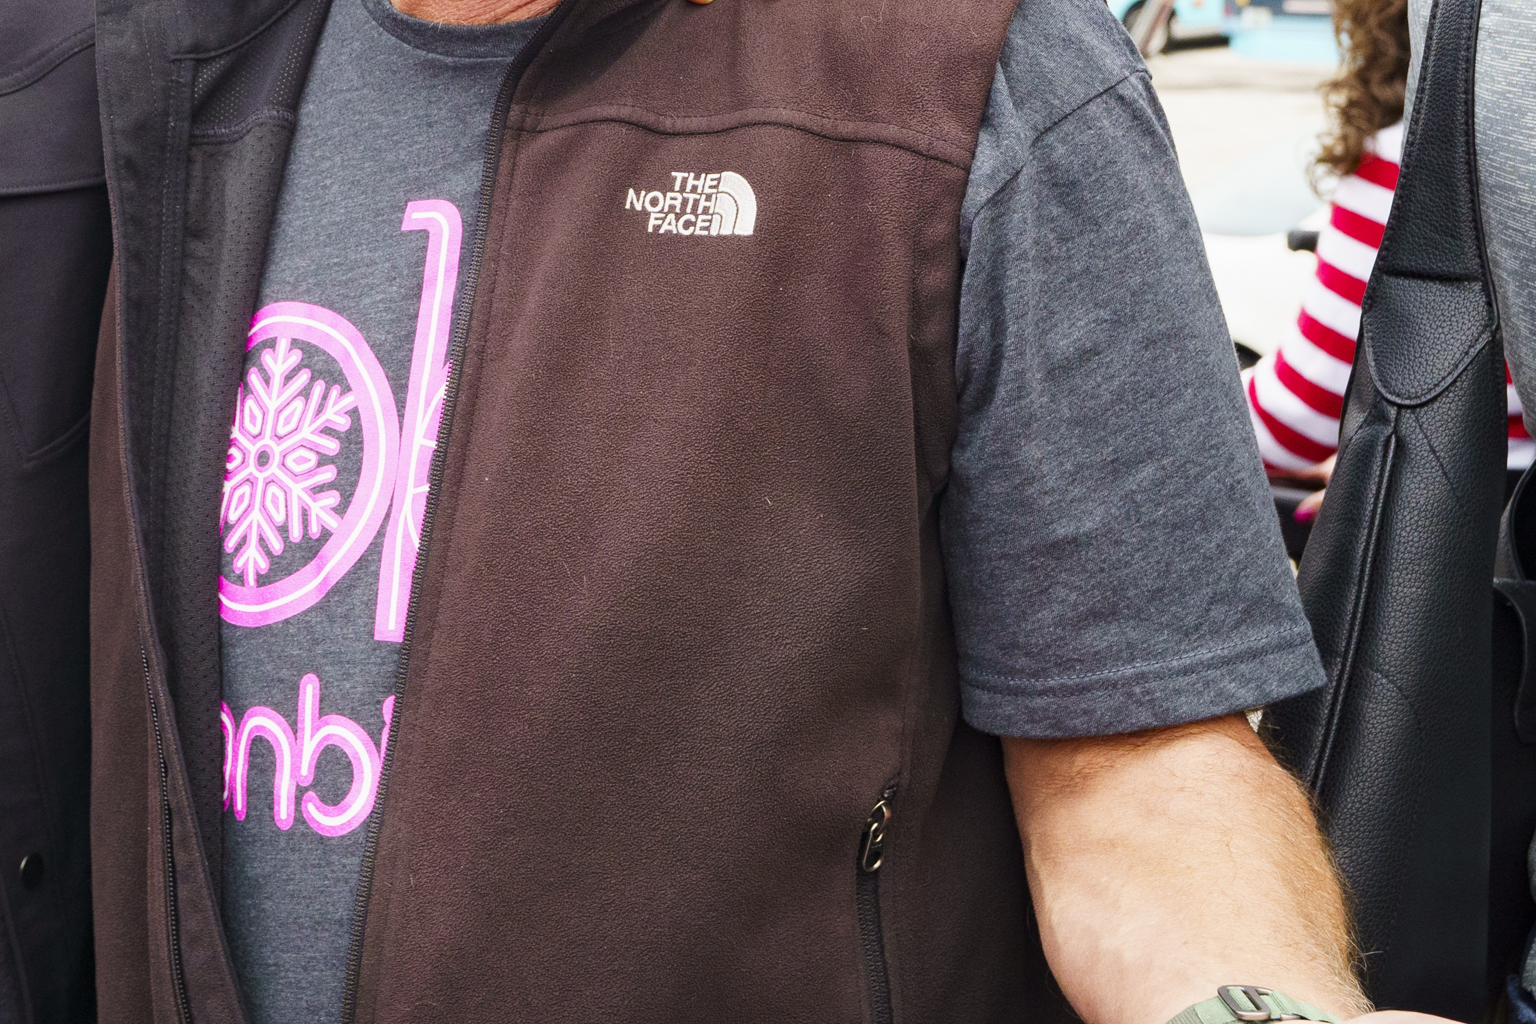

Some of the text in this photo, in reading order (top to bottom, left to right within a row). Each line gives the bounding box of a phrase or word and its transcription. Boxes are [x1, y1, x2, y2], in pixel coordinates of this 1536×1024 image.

[671, 172, 721, 193] THE
[625, 188, 716, 214] NORTH
[647, 212, 713, 236] FACE
